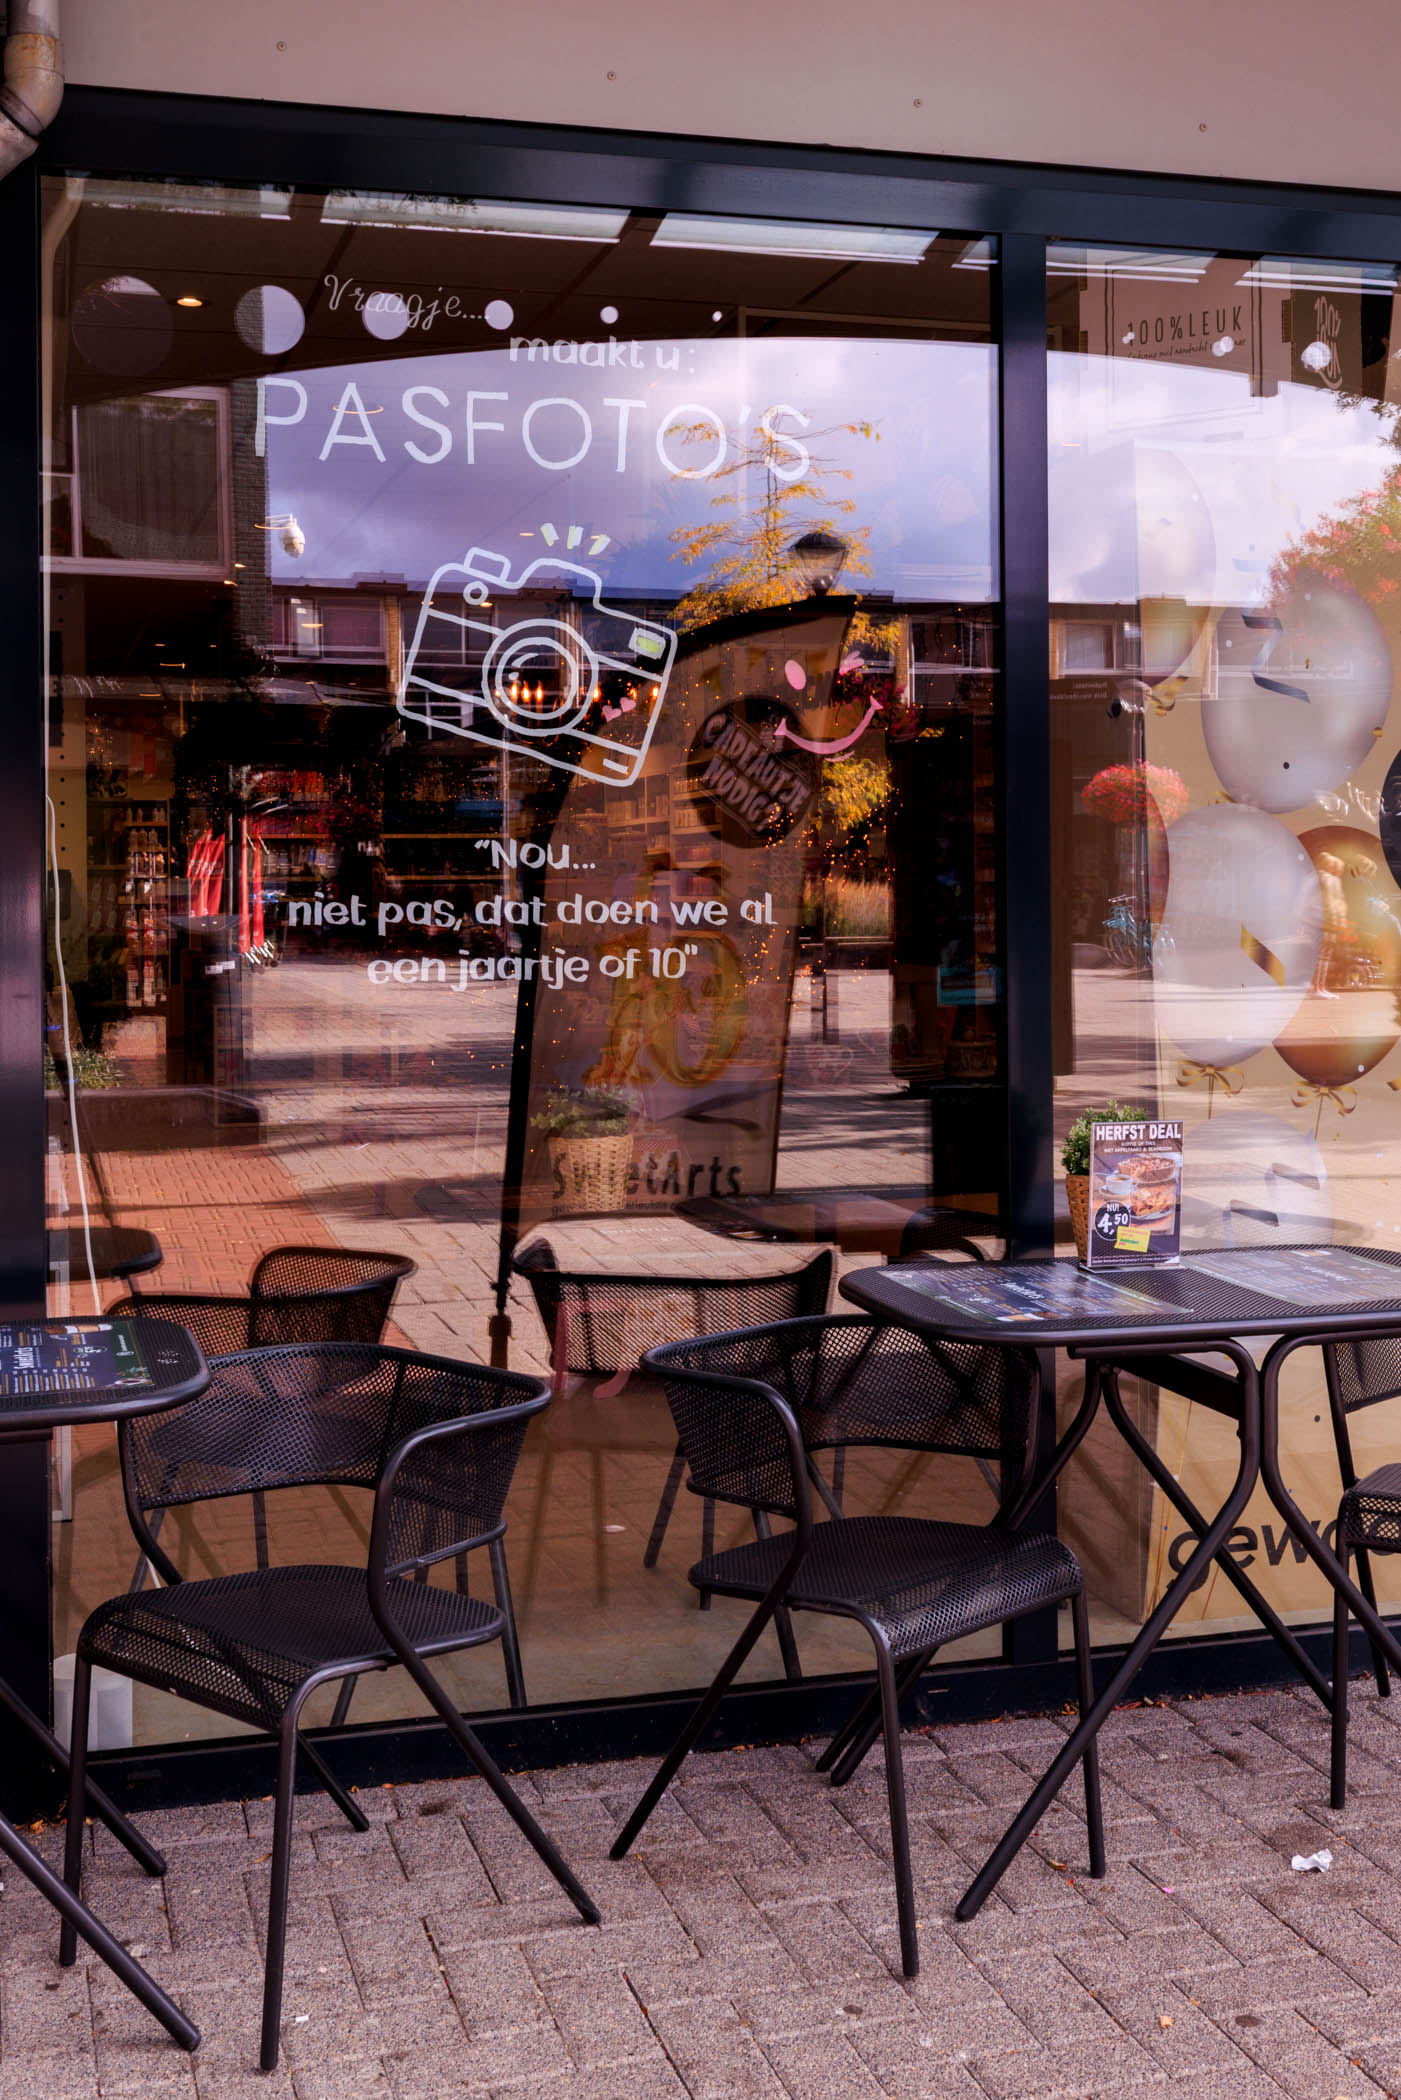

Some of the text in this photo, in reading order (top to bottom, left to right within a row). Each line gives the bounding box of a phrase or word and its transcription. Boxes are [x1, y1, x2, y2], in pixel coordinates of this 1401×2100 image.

[509, 335, 646, 370] maakt
[254, 376, 812, 483] PASFOTO'S
[474, 838, 597, 870] "Nou...
[288, 891, 779, 937] niet pas, dat doen we al
[367, 942, 699, 992] een jaartje of 10"
[1095, 1123, 1181, 1141] HERFST DEAL
[1097, 1213, 1128, 1235] 4,50
[1106, 1203, 1120, 1212] NU!
